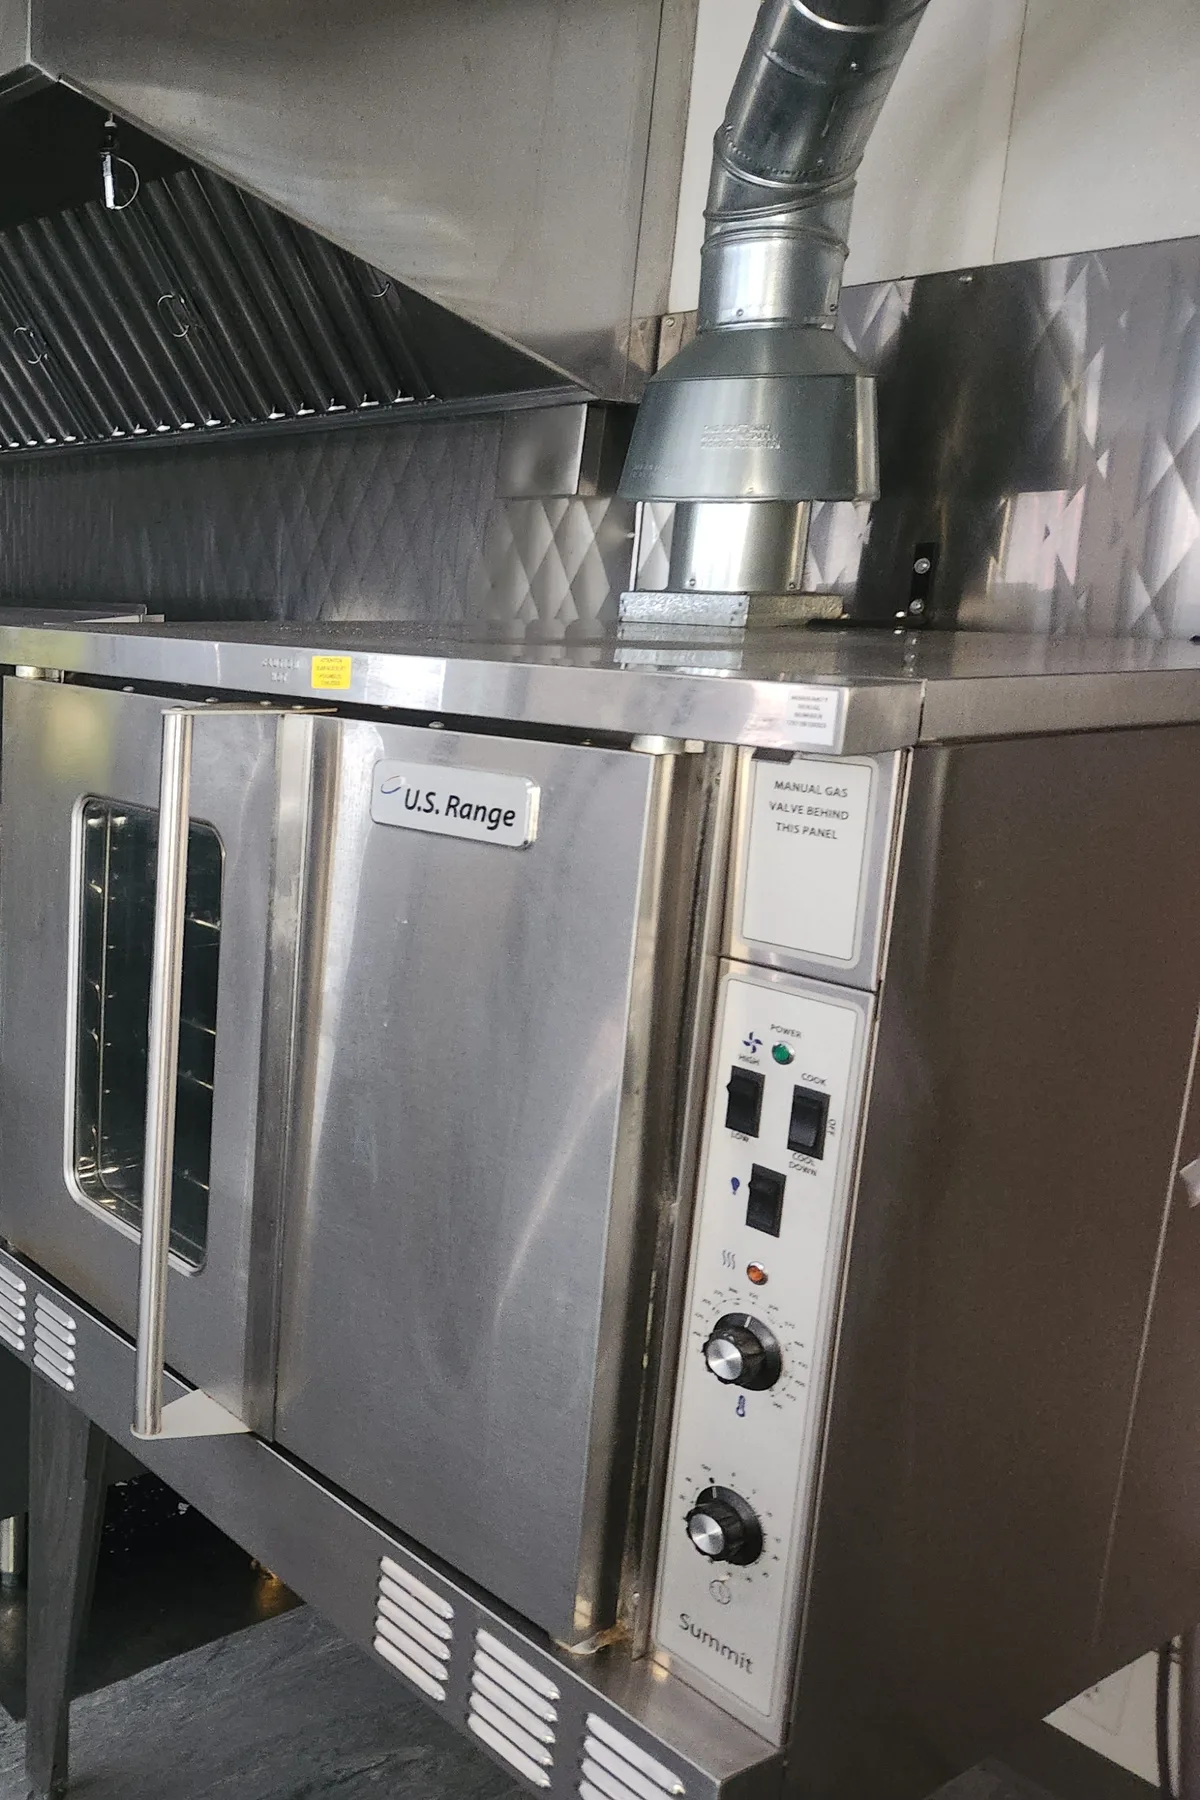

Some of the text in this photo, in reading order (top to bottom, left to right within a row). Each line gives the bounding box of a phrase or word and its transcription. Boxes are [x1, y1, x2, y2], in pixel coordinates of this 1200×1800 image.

[773, 780, 849, 798] MANUAL GAS
[404, 788, 516, 831] U.S. Range
[769, 800, 849, 821] VALVE BEHIND
[776, 821, 838, 840] THIS PANEL
[770, 1023, 802, 1038] POWER
[801, 1072, 827, 1086] COOK
[679, 1612, 753, 1675] Summit
